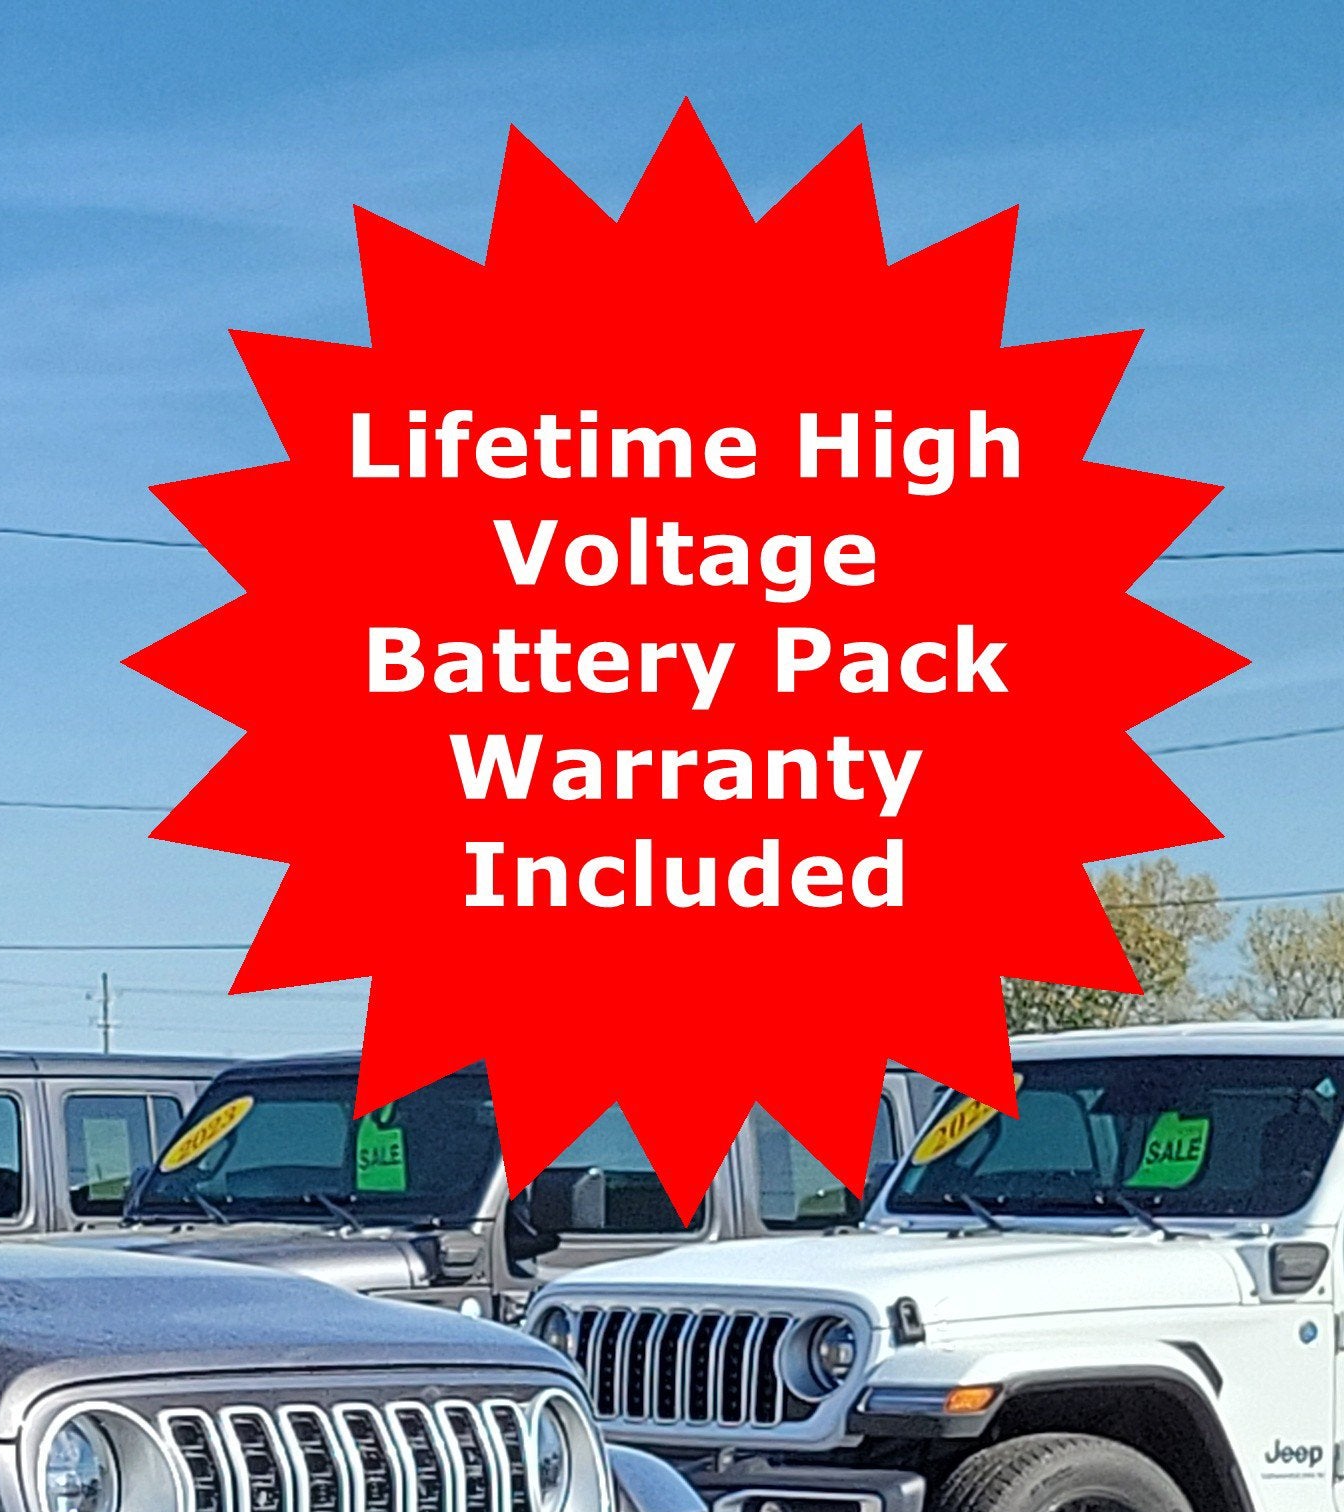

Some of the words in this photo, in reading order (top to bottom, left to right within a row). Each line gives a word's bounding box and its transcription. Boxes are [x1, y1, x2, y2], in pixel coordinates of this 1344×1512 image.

[932, 1099, 998, 1153] 202
[358, 1142, 403, 1172] SALE
[1145, 1136, 1202, 1166] SALE
[1264, 1438, 1324, 1469] Jeep
